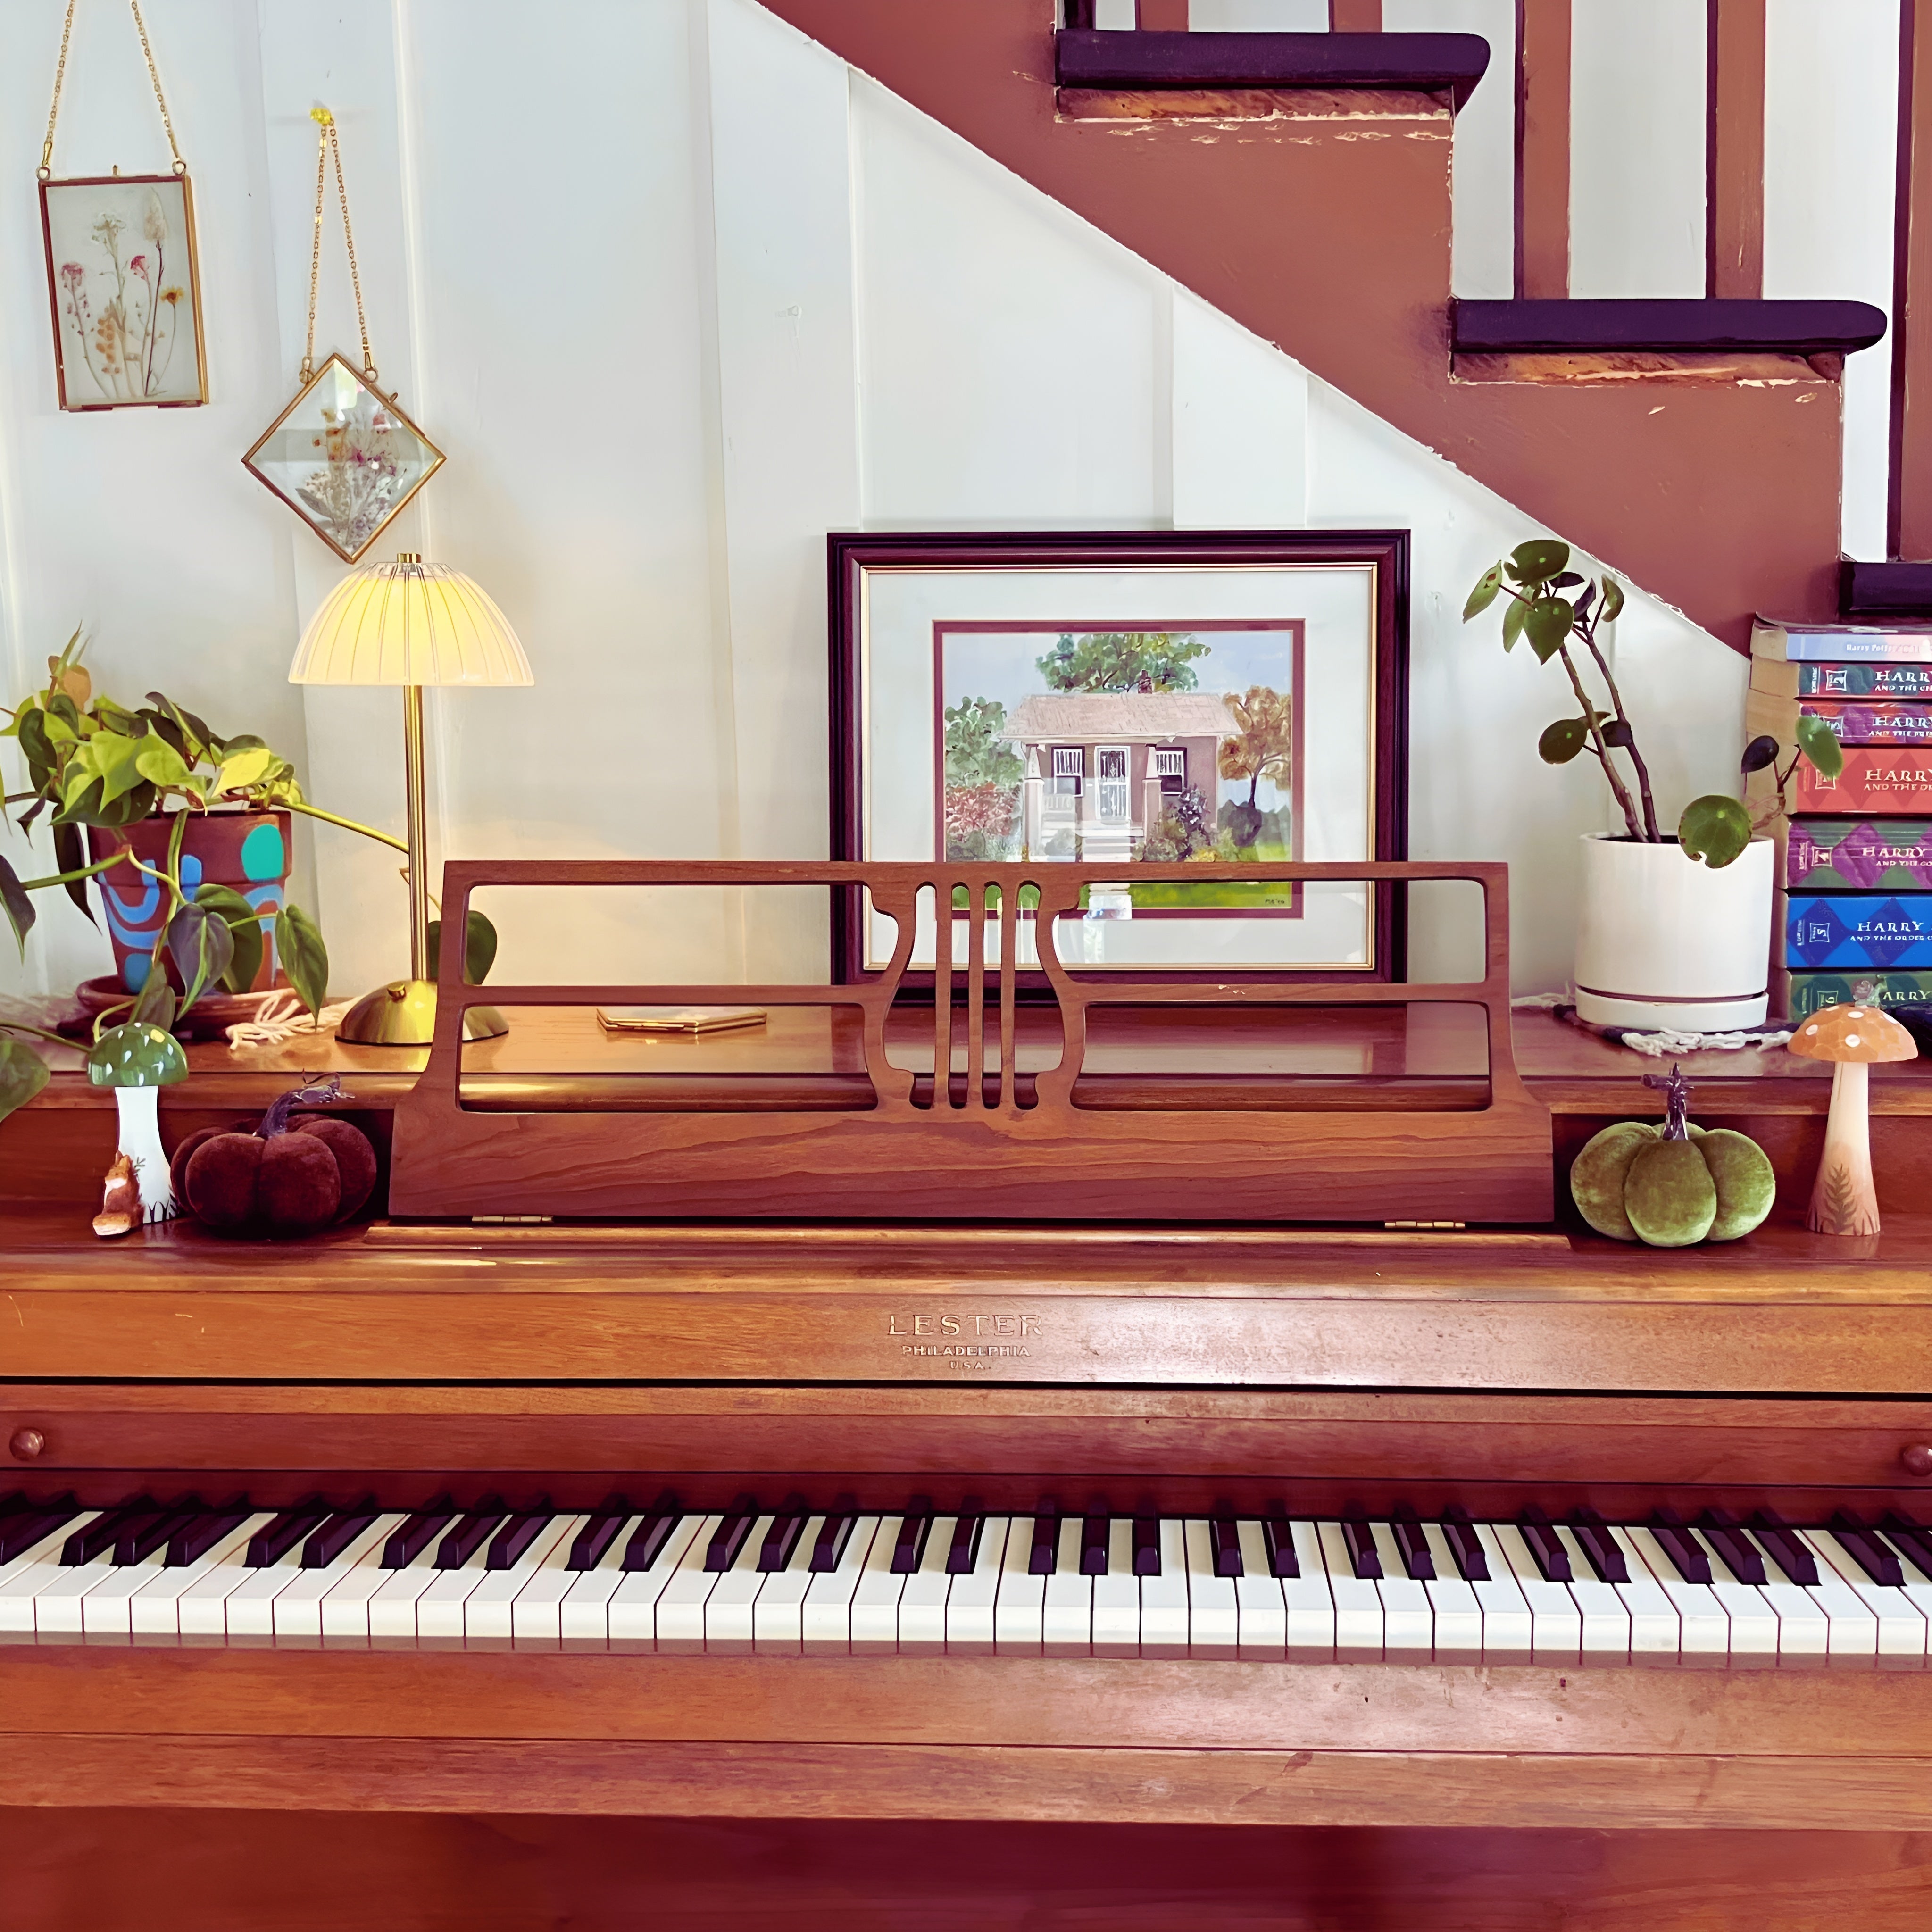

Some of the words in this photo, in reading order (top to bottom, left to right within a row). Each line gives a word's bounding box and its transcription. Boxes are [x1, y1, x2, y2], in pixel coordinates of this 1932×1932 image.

[1875, 670, 1932, 682] HARR
[1862, 846, 1925, 858] HARRY
[1857, 921, 1924, 932] HARRY
[1882, 990, 1932, 1001] ARRY
[887, 1314, 1043, 1336] LESTER
[902, 1345, 1031, 1357] PHILADELPHIA
